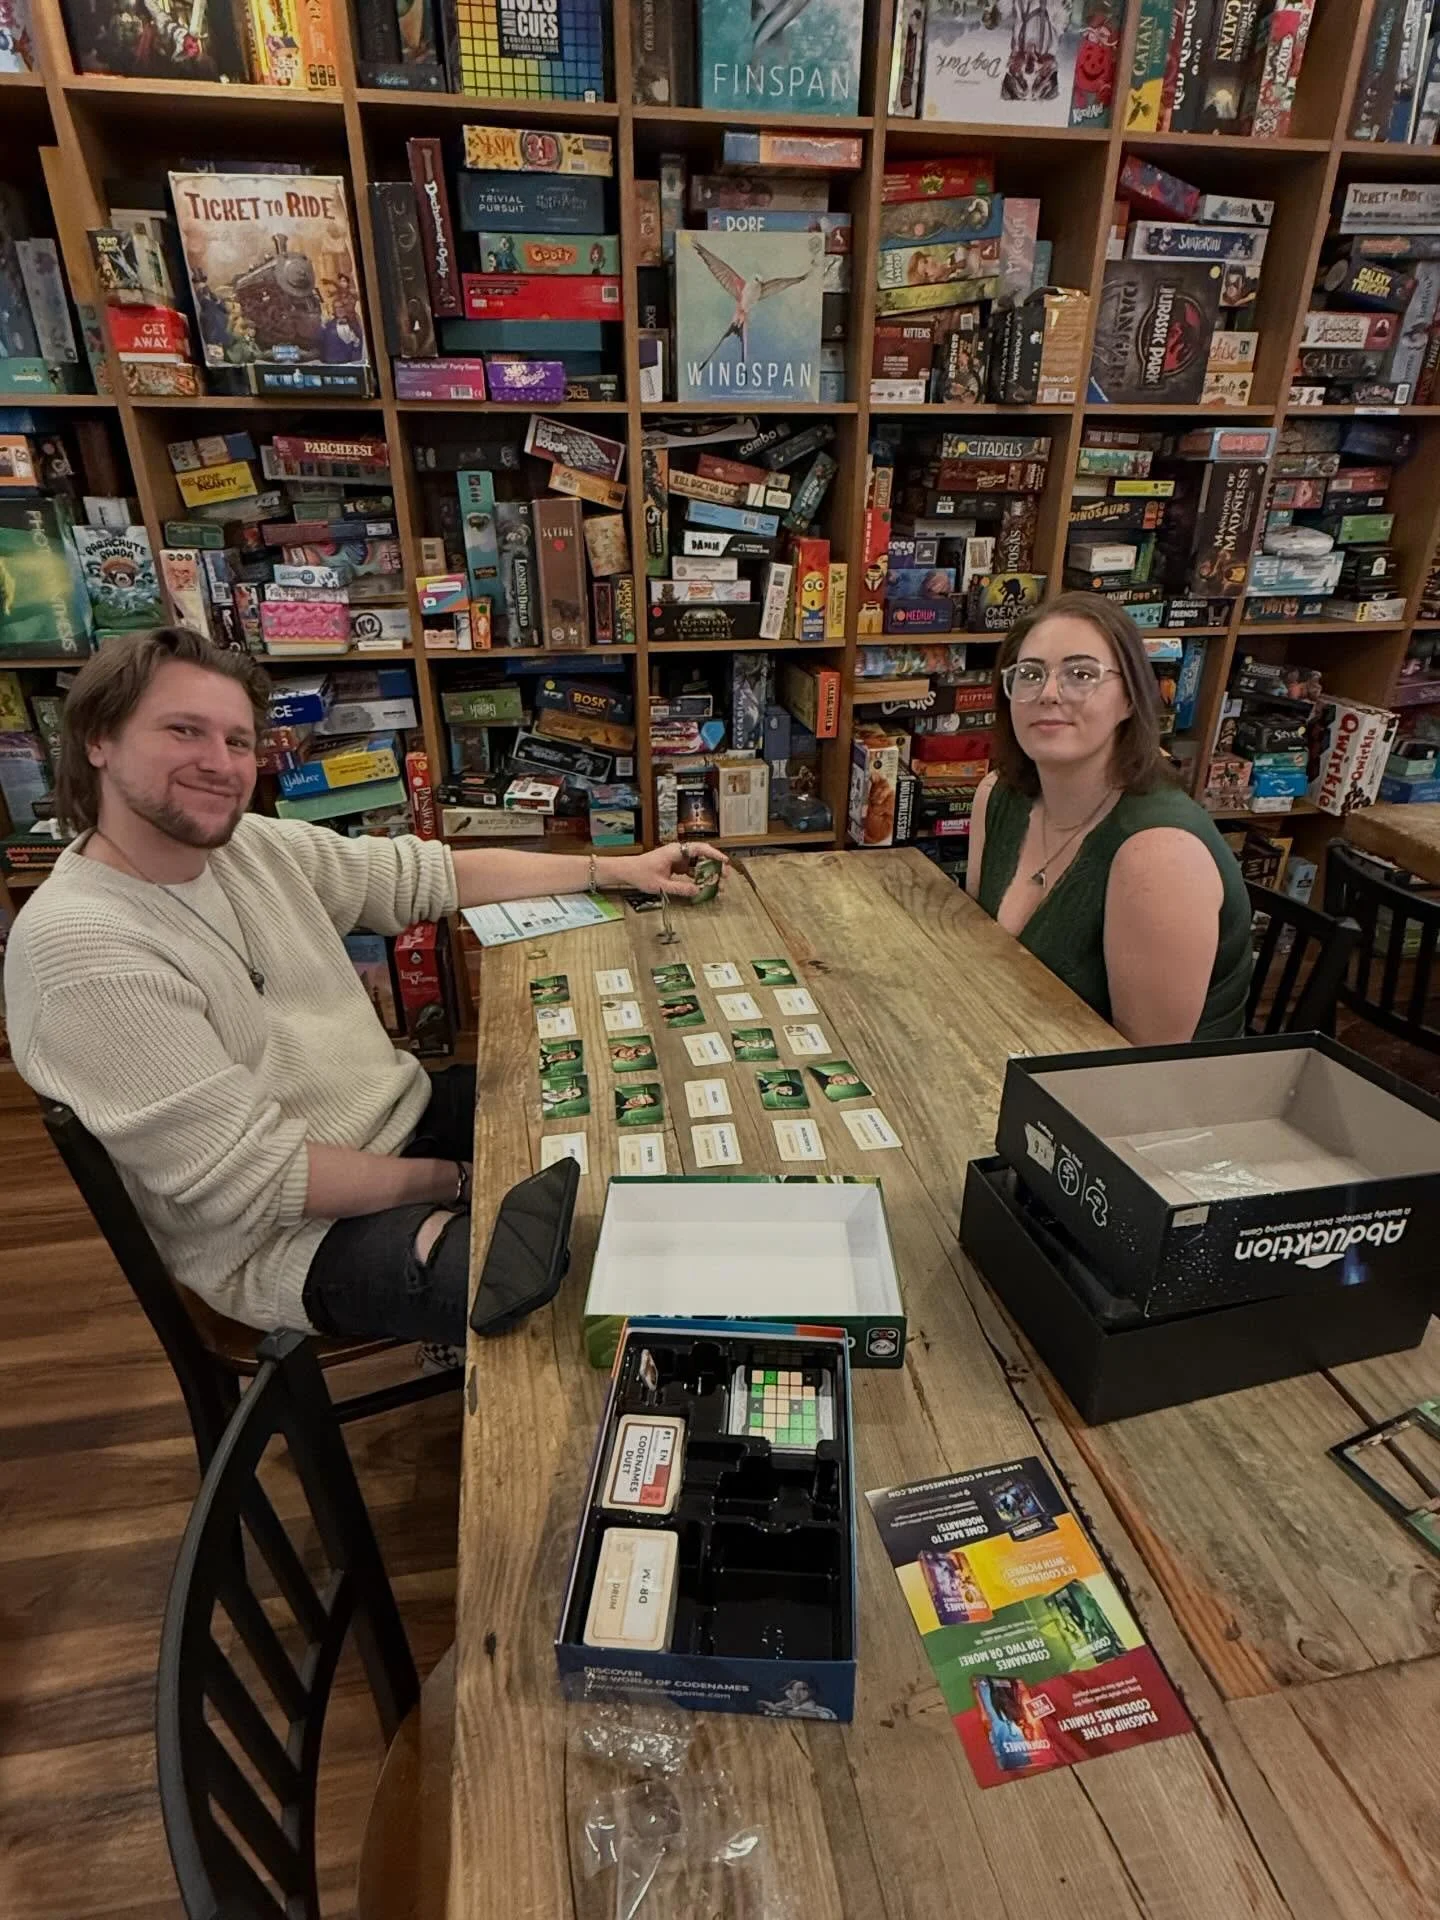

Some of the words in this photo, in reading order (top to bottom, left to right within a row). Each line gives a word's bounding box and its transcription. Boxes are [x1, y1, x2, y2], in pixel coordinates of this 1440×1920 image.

[502, 12, 517, 36] AND
[517, 14, 558, 38] CUES
[1216, 0, 1241, 61] CATAN
[1234, 2, 1251, 62] THRONES
[1133, 16, 1155, 77] CATAN
[936, 55, 970, 78] Park
[972, 52, 1001, 78] Dog
[1277, 36, 1293, 83] AZUL
[713, 63, 850, 99] FINSPAN
[480, 194, 522, 204] TRIVIAL
[1352, 188, 1389, 204] TICKET
[1400, 188, 1424, 202] RIDE
[184, 191, 260, 221] TICKET
[264, 200, 282, 216] TO
[285, 192, 336, 220] RIDE
[478, 204, 527, 214] PURSUIT
[1358, 267, 1392, 288] GALAXY
[1351, 278, 1391, 299] TRUCKER
[1151, 287, 1176, 347] JURASSIC
[142, 323, 166, 336] GET
[904, 327, 931, 340] KITTENS
[950, 334, 960, 379] ARCHER
[1146, 346, 1168, 384] PARK
[688, 362, 812, 387] WINGSPAN
[538, 421, 566, 434] Super
[304, 441, 374, 456] PARCHEESI
[536, 438, 569, 452] Boggle
[739, 430, 777, 456] combo
[966, 441, 1023, 458] CITADELS
[199, 477, 238, 492] INSANITY
[674, 474, 690, 486] KILL
[692, 478, 719, 493] DOCTOR
[1069, 502, 1130, 522] DINOSAURS
[1214, 490, 1232, 546] MANSIONS
[1227, 473, 1236, 487] OF
[1224, 468, 1250, 550] MADNESS
[542, 527, 574, 537] SCYTHE
[85, 538, 147, 555] PARACHUTE
[100, 550, 134, 560] PANDA
[514, 559, 528, 595] LONDON
[518, 596, 530, 626] DREAD
[906, 608, 936, 620] MEDIUM
[986, 608, 1006, 618] ONE
[1170, 609, 1198, 618] FRIENDS
[674, 617, 736, 626] LEGENDARY
[573, 692, 606, 708] BOSK
[470, 703, 496, 718] Geek
[736, 692, 744, 750] CASCADIA
[1320, 712, 1360, 808] Qwirkle
[1351, 728, 1378, 781] Qwirkle
[282, 773, 320, 792] Yahtzee
[416, 786, 432, 834] PASSWORD
[897, 781, 910, 840] GUESSTIMATION
[1313, 1218, 1333, 1226] Duck
[1336, 1212, 1373, 1222] Strategic
[1374, 1209, 1403, 1219] Weirdly
[1239, 1226, 1263, 1237] Game
[1265, 1220, 1312, 1233] Kidnapping
[1234, 1218, 1408, 1262] Abducktion
[662, 1430, 671, 1440] #1
[622, 1450, 634, 1474] DUET
[630, 1435, 648, 1494] CODENAMES
[660, 1450, 668, 1462] EN
[984, 1468, 1001, 1478] more
[1002, 1464, 1022, 1474] Learn
[887, 1474, 975, 1498] CODENAMESGAME.COM
[936, 1515, 984, 1532] HOGWARTS!
[965, 1524, 988, 1537] COME
[930, 1534, 943, 1544] TO
[943, 1529, 964, 1540] BACK
[610, 1582, 620, 1610] DRUM
[988, 1645, 1003, 1659] OR
[1026, 1636, 1044, 1651] FOR
[960, 1648, 988, 1667] MORE!
[995, 1648, 1050, 1671] CODENAMES
[584, 1666, 642, 1677] DISCOVER
[610, 1676, 654, 1686] WORLD
[656, 1678, 672, 1686] OF
[674, 1680, 750, 1693] CODENAMES
[1095, 1698, 1151, 1720] CODENAMES
[1058, 1712, 1095, 1732] FAMILY!
[1100, 1722, 1114, 1734] OF
[1114, 1710, 1158, 1731] FLAGSHIP
[1081, 1725, 1100, 1740] THE
[1003, 1740, 1051, 1754] CODENAMES
